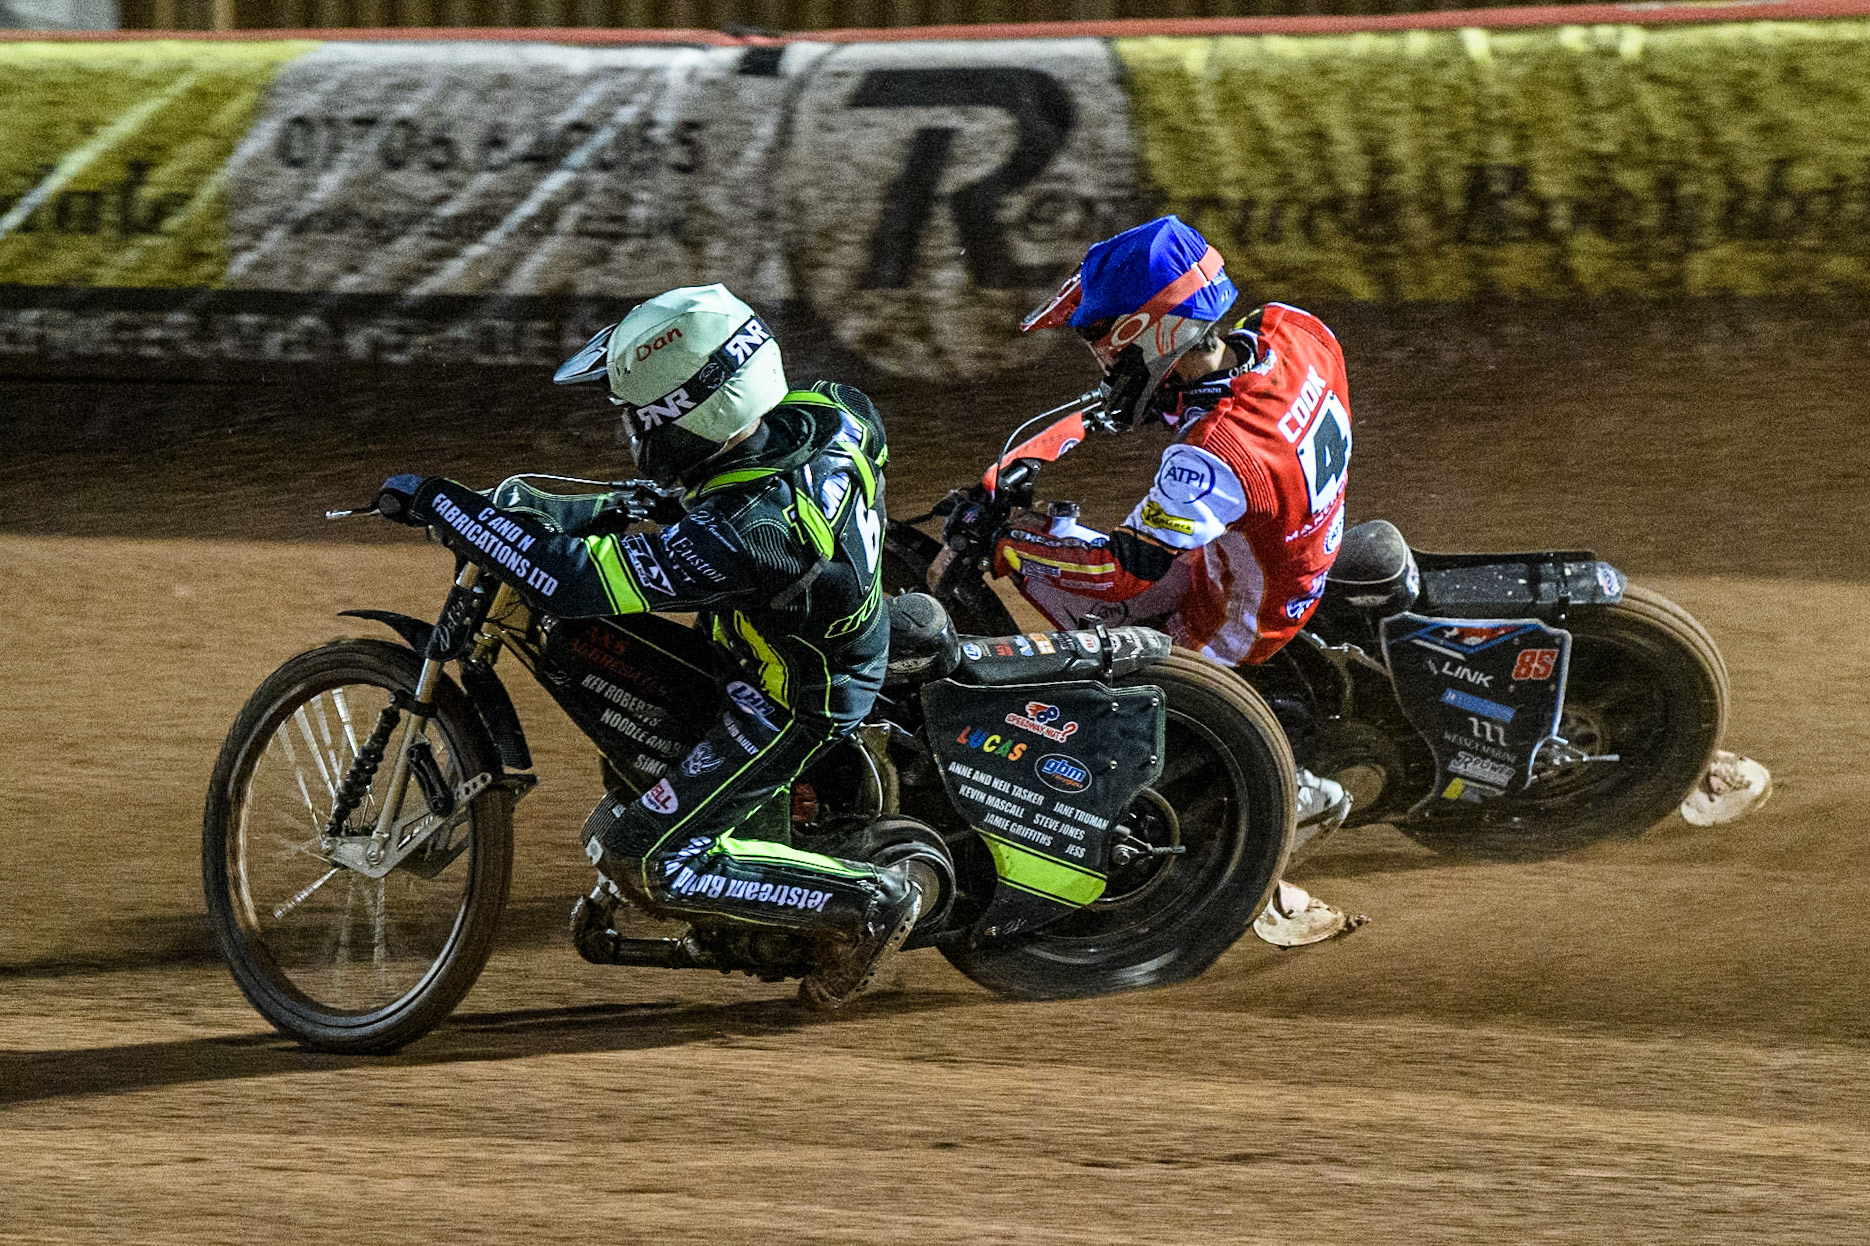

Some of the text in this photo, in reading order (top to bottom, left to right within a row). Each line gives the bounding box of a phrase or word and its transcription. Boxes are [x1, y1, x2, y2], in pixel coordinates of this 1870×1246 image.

[635, 327, 683, 363] Dan
[1277, 364, 1327, 444] COOK
[1313, 408, 1349, 497] 4
[1164, 465, 1205, 489] ATPI
[431, 492, 559, 597] FABRICATIONS LTD
[478, 507, 537, 553] C AND N
[672, 537, 727, 583] Euston
[1441, 661, 1495, 688] LINK
[1512, 648, 1559, 680] 85
[581, 673, 608, 694] KEV
[600, 708, 648, 743] NOODLE
[1007, 714, 1045, 733] SPEEDWAY
[957, 726, 1028, 761] LUCAS
[948, 761, 1045, 806] ANNE AND NEIL TASKER
[1042, 758, 1087, 782] gbm
[959, 784, 1025, 819] KEVIN MASCALL
[1053, 802, 1109, 831] JANE TRUMAN
[983, 812, 1053, 847] JAMIE GRIFFITHS
[1033, 813, 1086, 841] STEVE JONES
[1065, 843, 1087, 858] JESS
[725, 879, 834, 912] Jetstream
